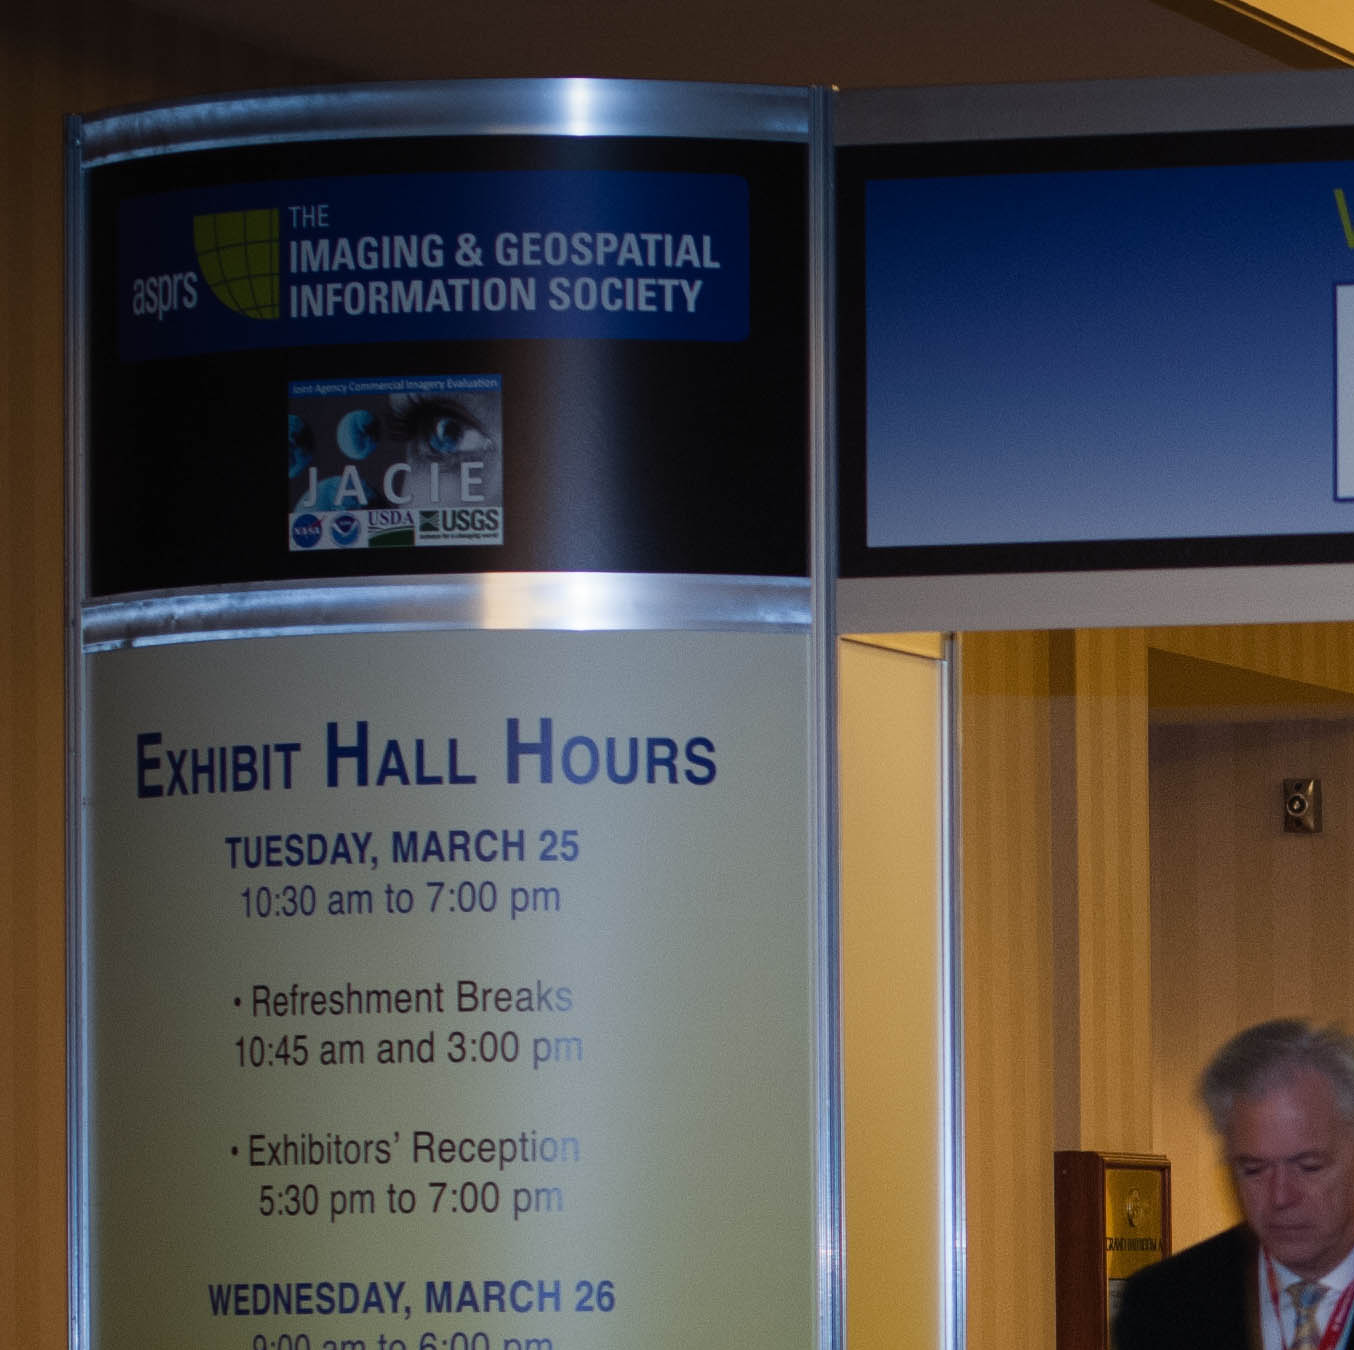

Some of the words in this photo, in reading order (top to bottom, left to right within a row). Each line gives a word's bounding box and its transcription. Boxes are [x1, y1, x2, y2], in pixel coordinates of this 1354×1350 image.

[289, 205, 329, 229] THE
[289, 236, 444, 273] IMAGING
[456, 235, 483, 269] &
[495, 232, 721, 269] GEOSPATIAL
[132, 271, 198, 321] asprs
[289, 276, 538, 318] INFORMATION
[548, 278, 703, 313] SOCIETY
[368, 510, 414, 526] USDA
[442, 509, 499, 532] USGS
[225, 832, 378, 872] TUESDAY,
[391, 831, 525, 865] MARCH
[538, 829, 579, 862] 25
[241, 886, 316, 918] 10:30
[327, 891, 373, 915] am
[385, 885, 414, 913] to
[426, 882, 497, 912] 7:00
[510, 886, 560, 919] pm
[252, 981, 443, 1018] Refreshment
[457, 979, 572, 1013] Breaks
[234, 1035, 308, 1067] 10:45
[321, 1041, 365, 1065] am
[376, 1033, 434, 1064] and
[447, 1031, 519, 1063] 3:00
[533, 1037, 583, 1070] pm
[413, 1130, 580, 1171] Reception
[259, 1184, 319, 1217] 5:30
[330, 1190, 375, 1222] pm
[387, 1184, 416, 1214] to
[428, 1181, 499, 1213] 7:00
[512, 1187, 563, 1220] pm
[208, 1282, 412, 1321] WEDNESDAY,
[425, 1280, 562, 1314] MARCH
[574, 1279, 615, 1313] 26
